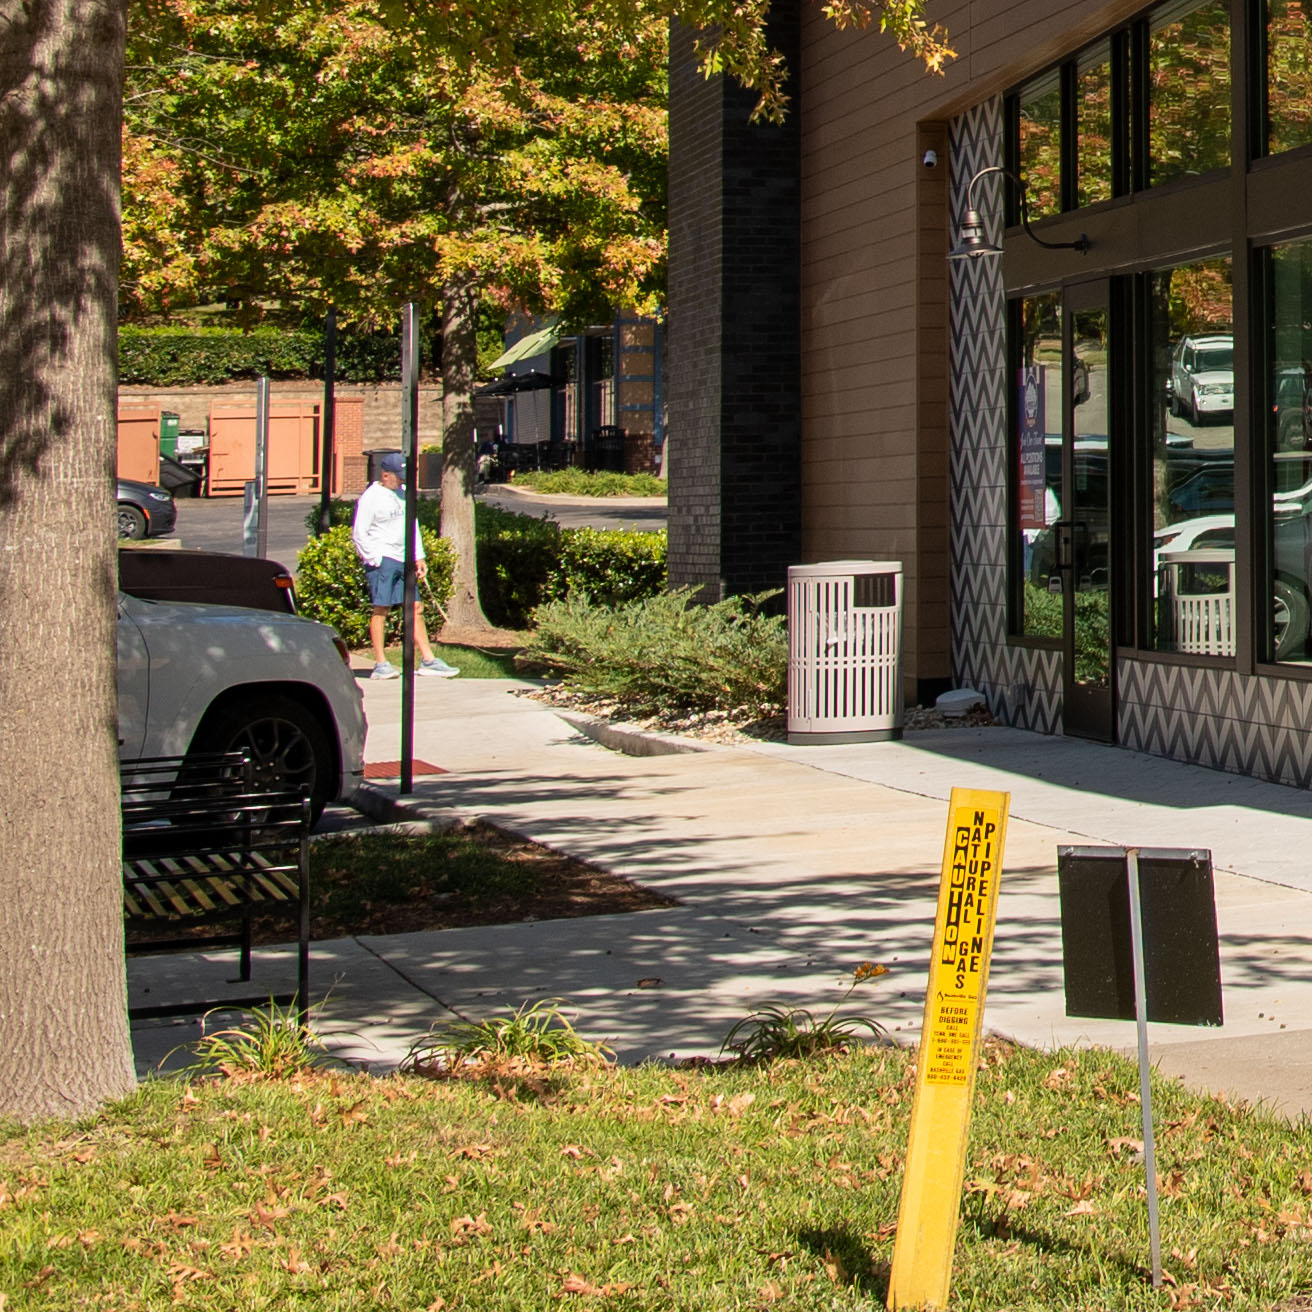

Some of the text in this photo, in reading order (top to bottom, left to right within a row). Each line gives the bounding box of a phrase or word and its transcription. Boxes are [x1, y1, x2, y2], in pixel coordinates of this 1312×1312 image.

[942, 827, 970, 964] CAUTION
[955, 811, 984, 989] NATURAL GAS
[970, 823, 995, 972] PIPELINE
